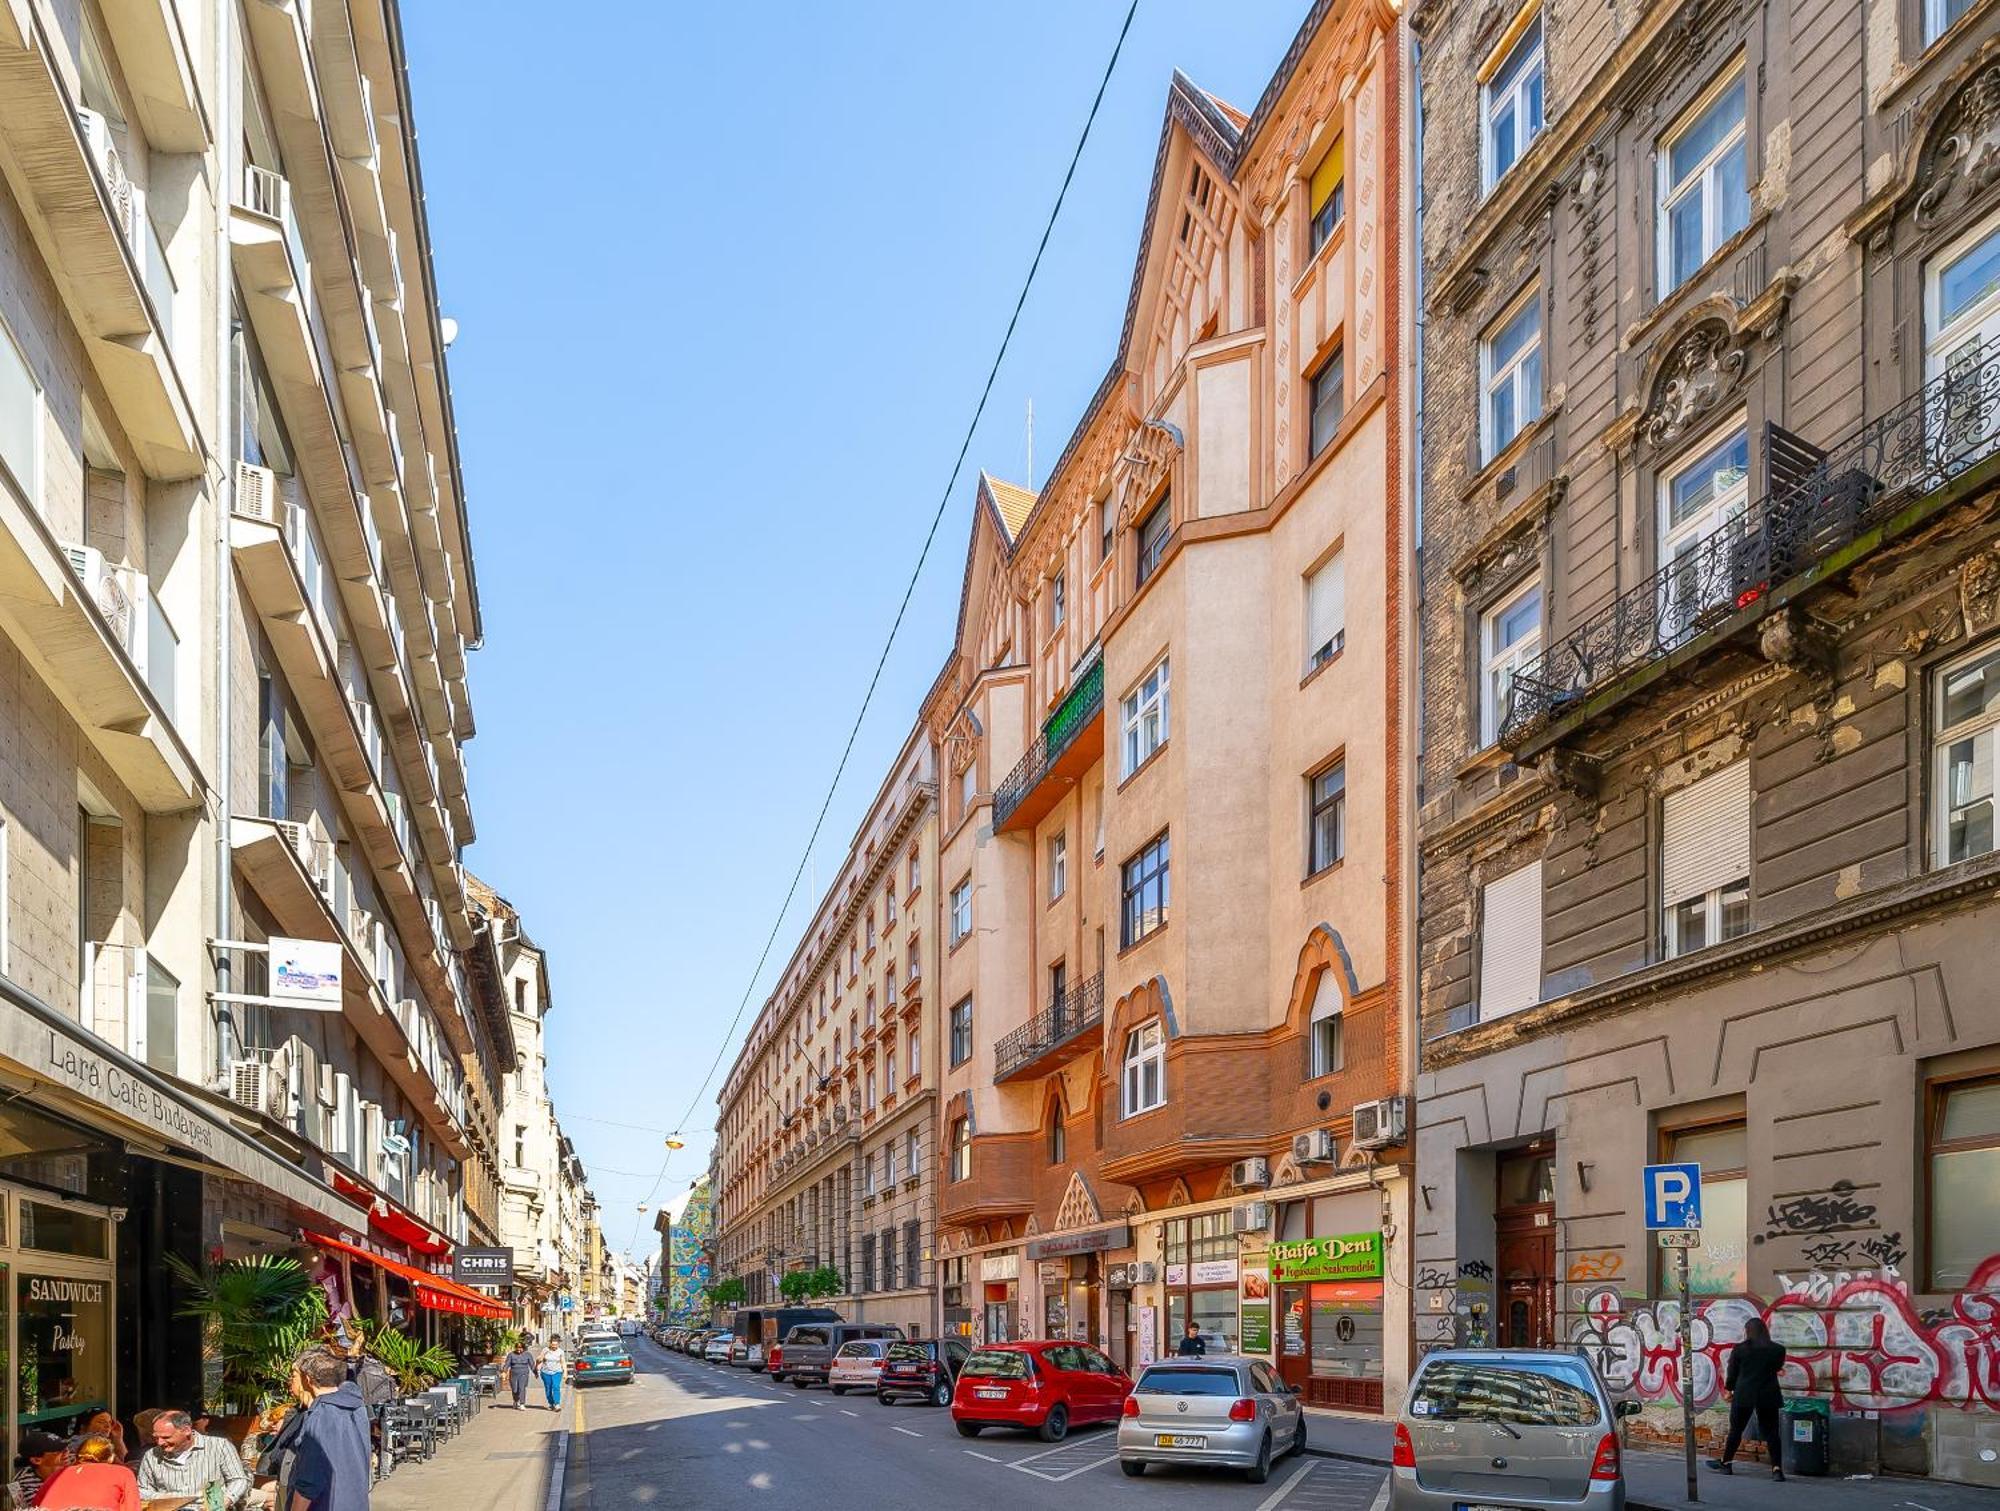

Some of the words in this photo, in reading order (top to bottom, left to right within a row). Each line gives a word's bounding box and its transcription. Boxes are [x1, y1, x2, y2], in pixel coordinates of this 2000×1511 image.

[152, 1091, 213, 1149] Budapest
[1655, 1171, 1691, 1222] P
[461, 1257, 508, 1269] CHRIS
[1271, 1242, 1319, 1264] Haifa
[1322, 1238, 1373, 1260] Dent
[30, 1278, 103, 1303] SANDWICH
[51, 1324, 86, 1356] Pastry
